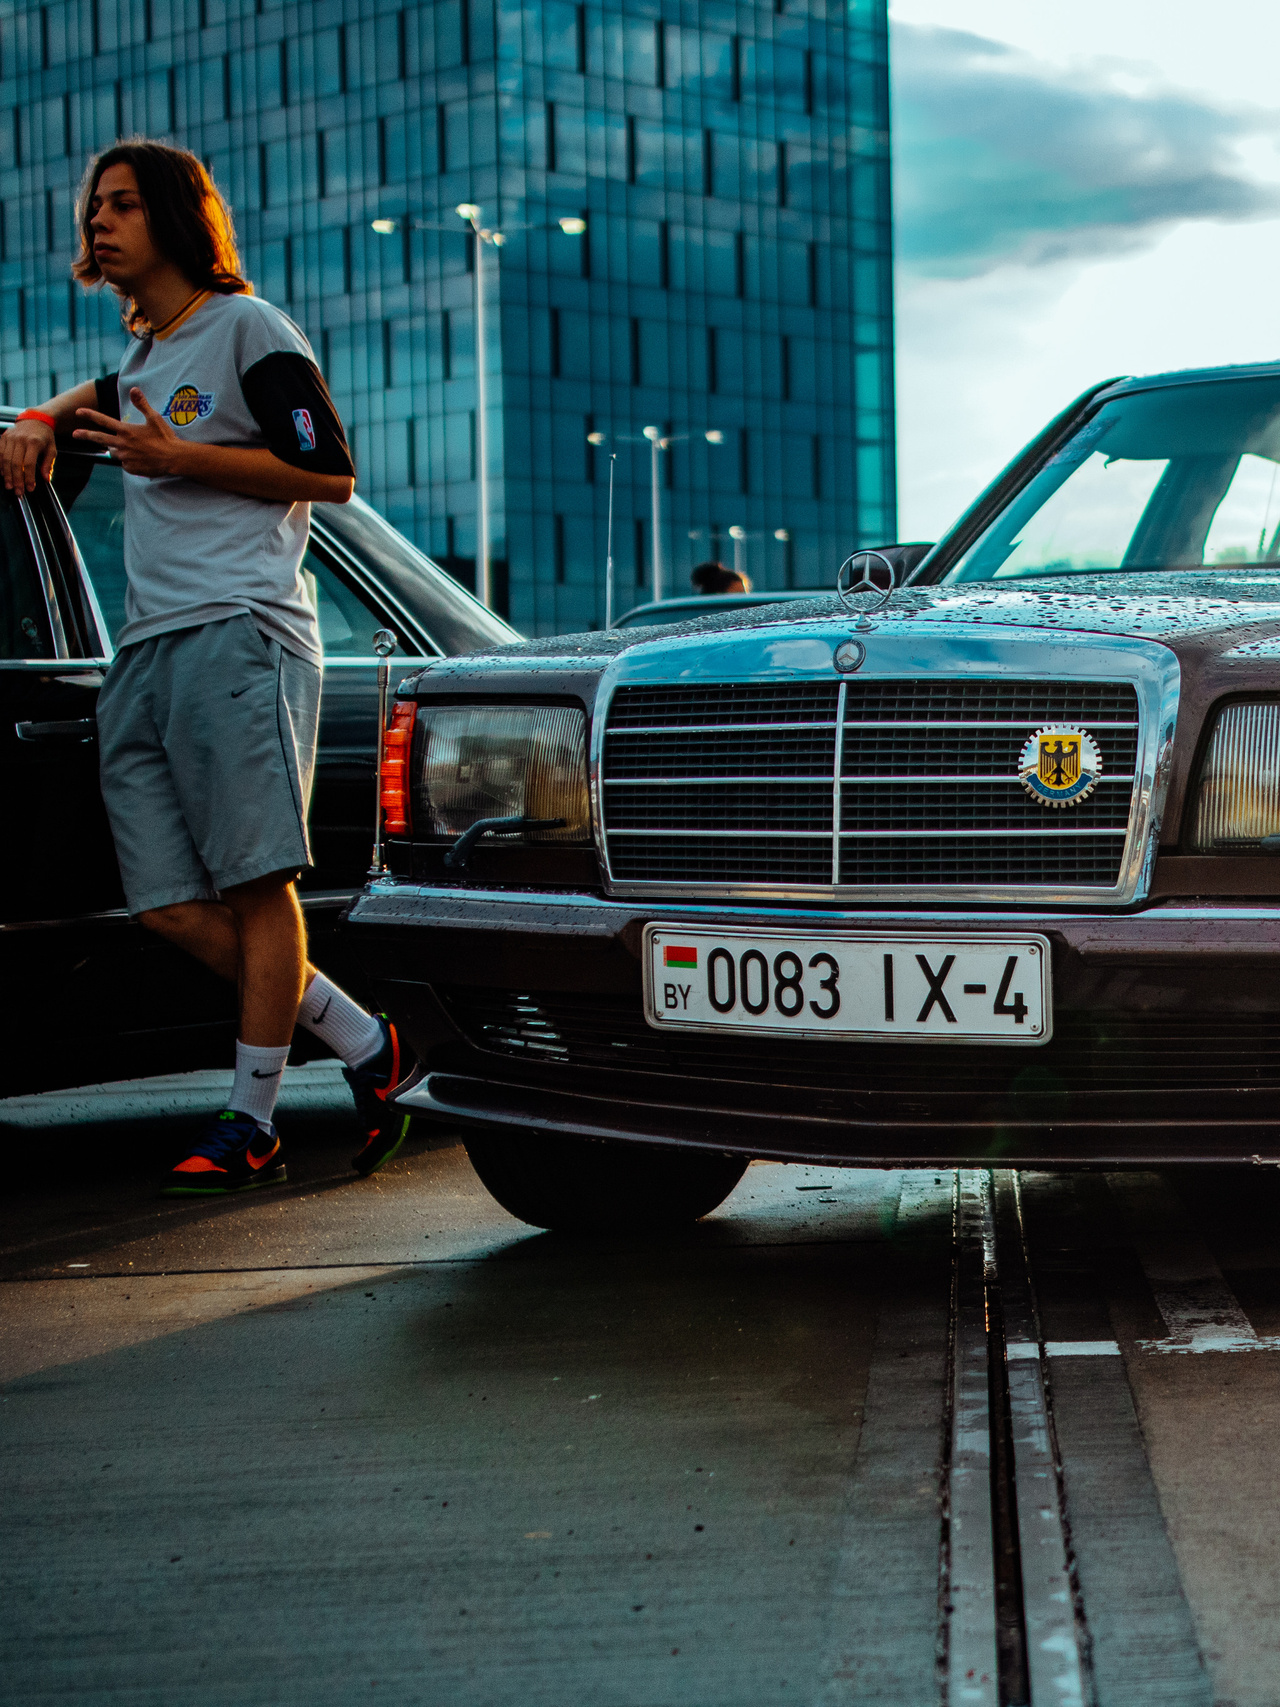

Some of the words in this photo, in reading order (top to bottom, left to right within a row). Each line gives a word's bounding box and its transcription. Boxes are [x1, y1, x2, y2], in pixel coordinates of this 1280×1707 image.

[162, 395, 213, 417] LAKERS
[1037, 782, 1083, 798] GERMANY
[663, 982, 692, 1011] BY
[706, 946, 841, 1019] 0083
[883, 953, 1029, 1024] IX-4
